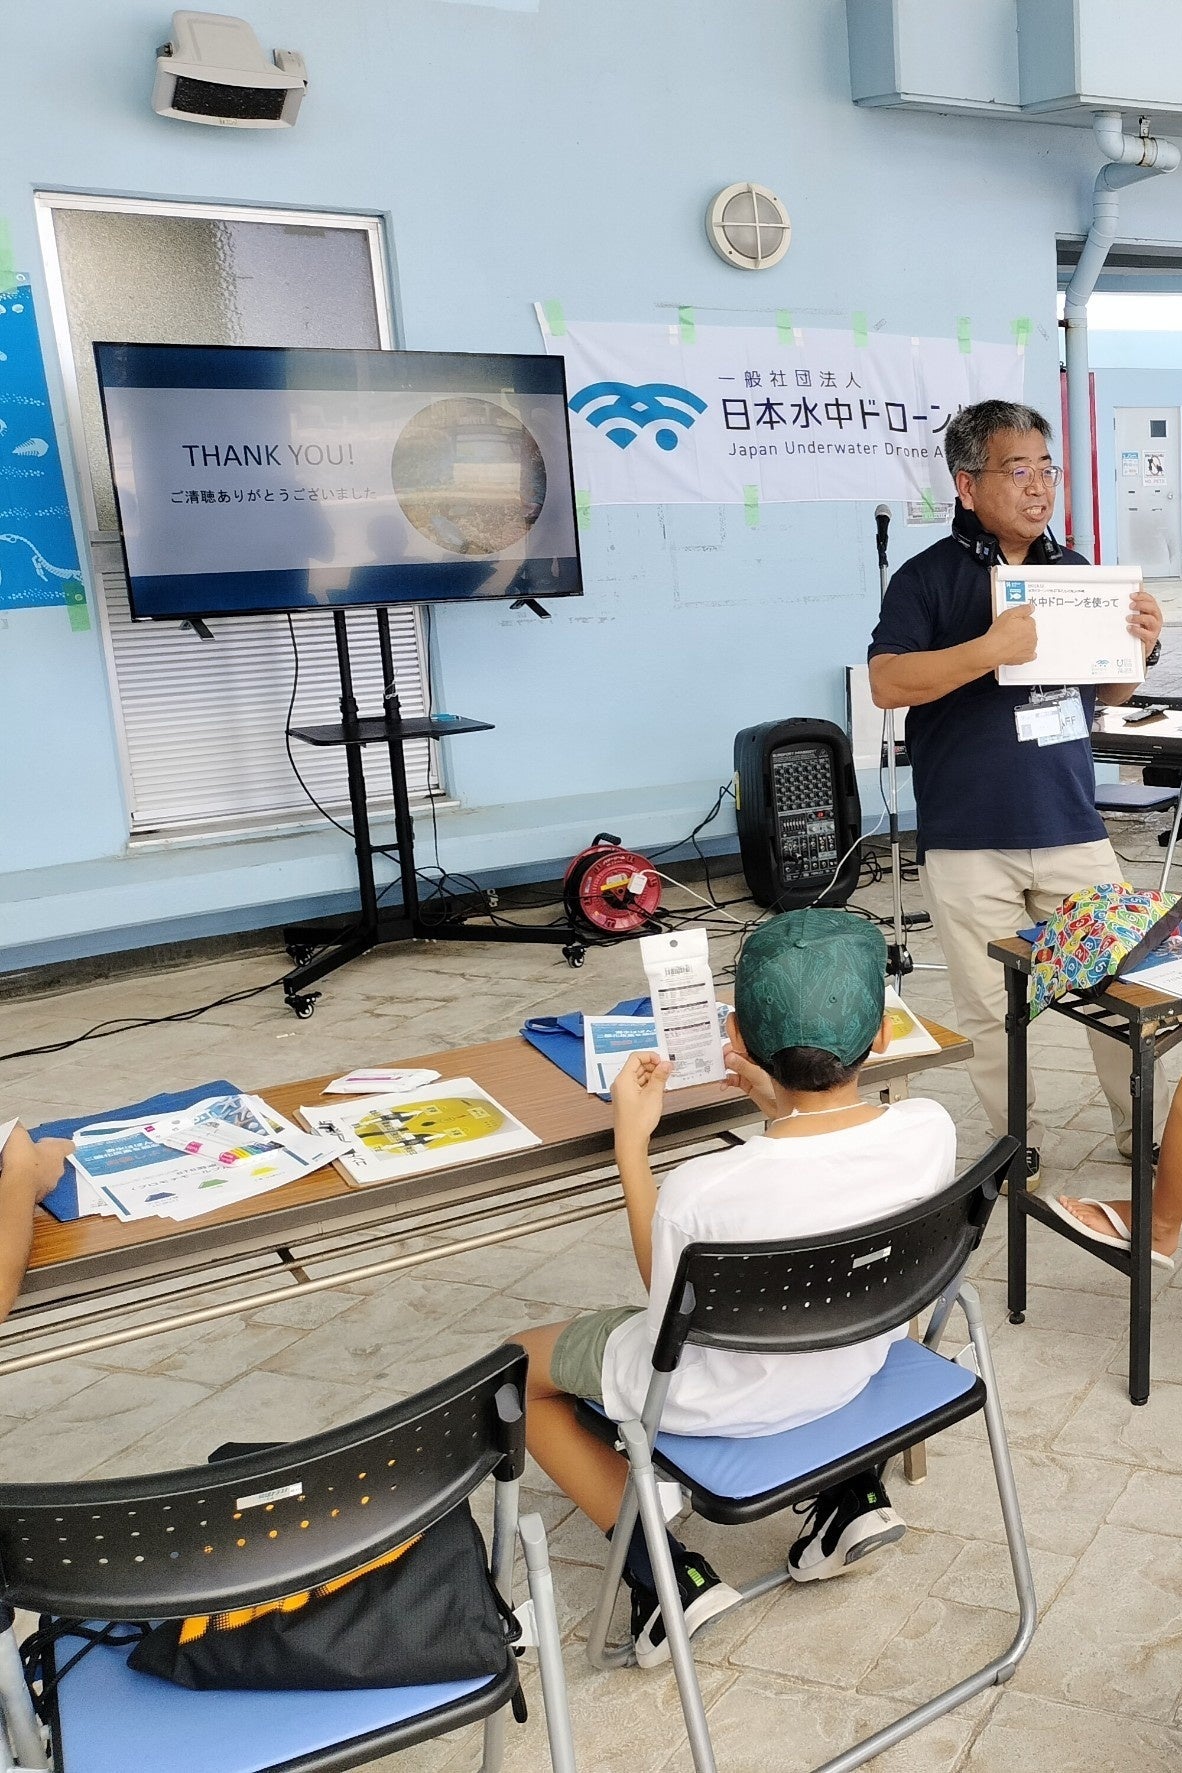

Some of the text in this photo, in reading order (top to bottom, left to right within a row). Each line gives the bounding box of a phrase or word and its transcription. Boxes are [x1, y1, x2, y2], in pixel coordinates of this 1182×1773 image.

[718, 369, 863, 390] 一般社団法人
[722, 396, 963, 434] 日本水中ドローン
[182, 442, 355, 467] THANK YOU!
[728, 441, 778, 460] Japan
[785, 440, 878, 457] Underwater
[885, 443, 928, 458] Drone
[169, 486, 377, 505] ご清聴ありがとうございました
[1028, 596, 1119, 609] 水中ドローンを使って
